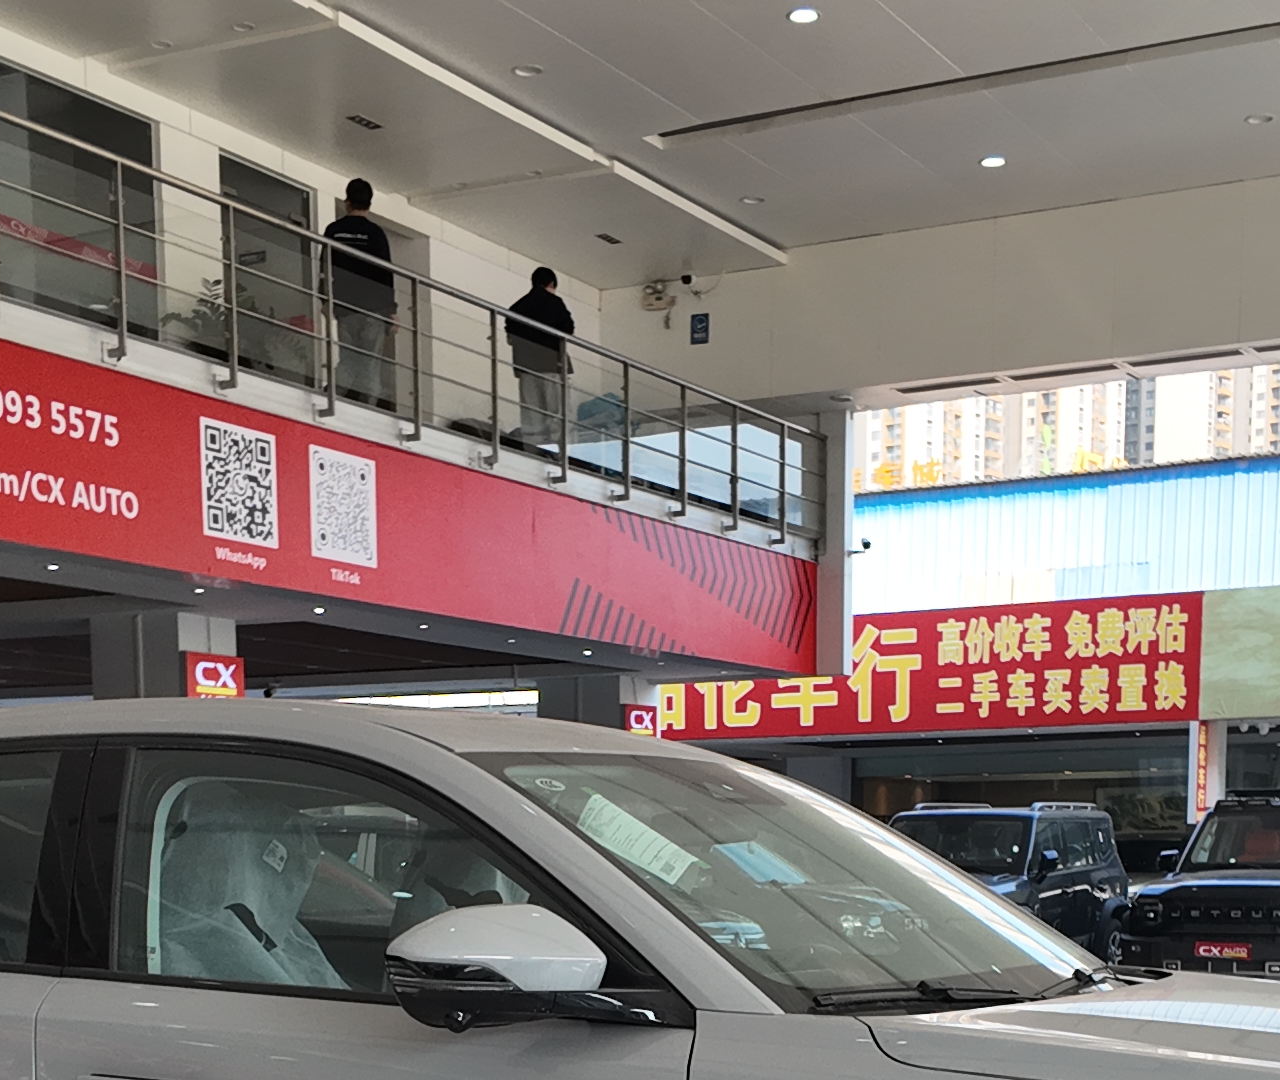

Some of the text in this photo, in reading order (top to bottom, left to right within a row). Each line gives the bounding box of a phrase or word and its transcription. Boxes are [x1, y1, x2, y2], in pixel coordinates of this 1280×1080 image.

[51, 401, 120, 448] 5575
[72, 480, 139, 520] AUTO
[215, 546, 267, 570] WhatsApp
[936, 603, 1187, 666] 高价收车 免费评估
[195, 661, 237, 688] CX
[936, 662, 1187, 718] 二手车买卖置换
[630, 710, 654, 729] CX
[1199, 945, 1221, 957] CX
